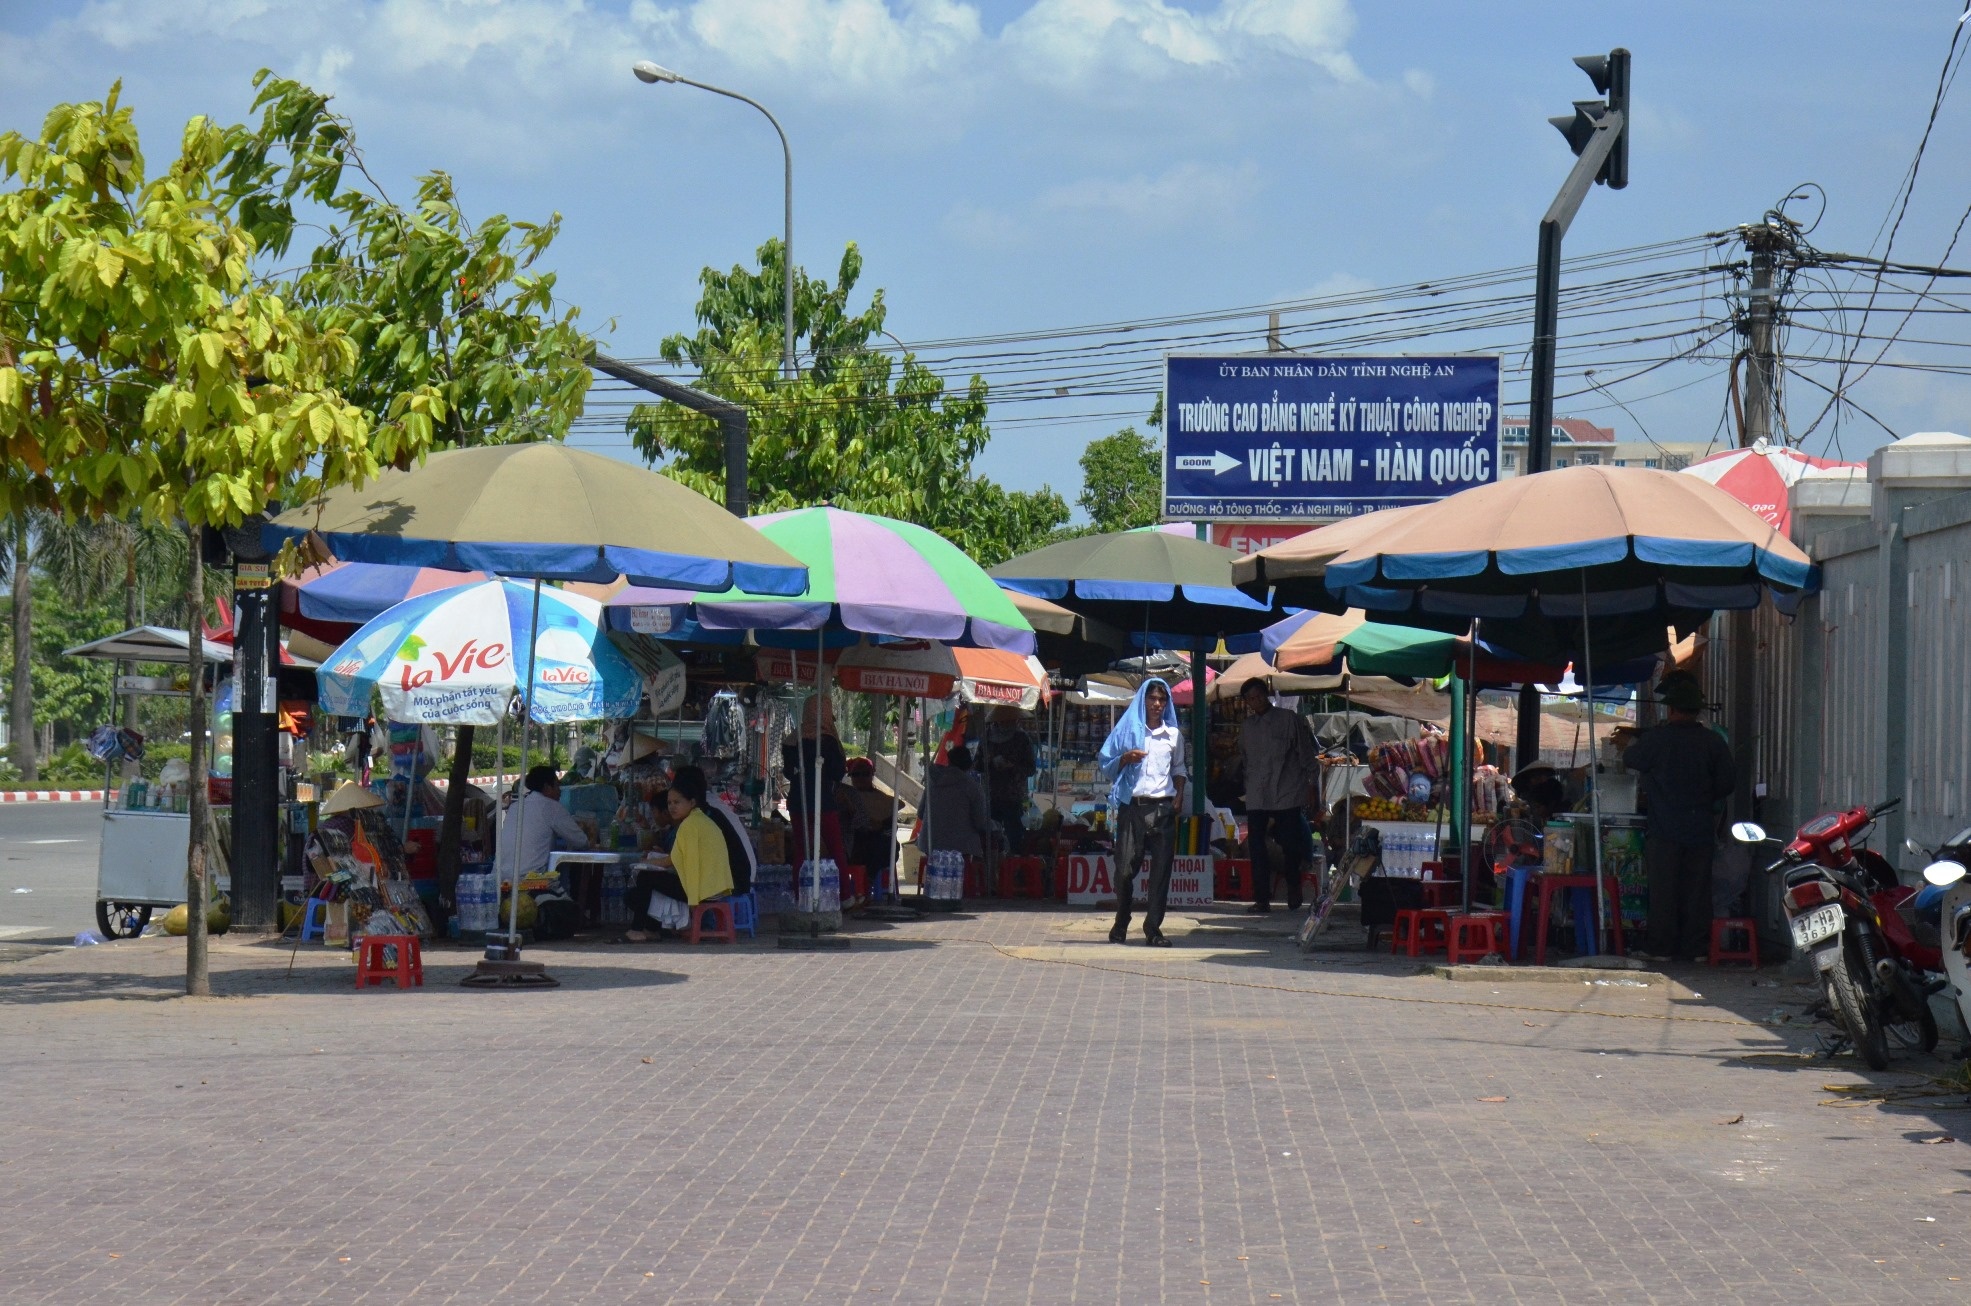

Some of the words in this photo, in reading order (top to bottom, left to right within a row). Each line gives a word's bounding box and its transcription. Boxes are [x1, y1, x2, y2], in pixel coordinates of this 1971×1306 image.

[1219, 362, 1238, 377] ỦY
[1241, 366, 1270, 377] BAN
[1274, 363, 1314, 377] NHÂN
[1317, 363, 1347, 377] DÂN
[1351, 361, 1387, 377] TỈNH
[1390, 363, 1431, 379] NGHỆ
[1434, 365, 1455, 376] AN
[1178, 395, 1230, 432] TRƯỜNG
[1232, 402, 1258, 432] CAO
[1261, 389, 1297, 432] ĐẲNG
[1300, 391, 1336, 432] NGHỀ
[1339, 396, 1357, 432] KỸ
[1360, 396, 1401, 437] THUẬT
[1403, 395, 1440, 432] CÔNG
[1443, 396, 1492, 437] NGHIỆP
[1182, 459, 1212, 467] 600M
[1248, 441, 1296, 488] VIỆT
[1301, 448, 1353, 482] NAM
[1375, 441, 1423, 482] HÀN
[1429, 435, 1490, 485] QUỐC
[1168, 502, 1207, 514] ĐƯỜNG:
[1226, 502, 1252, 514] TÔNG
[1254, 499, 1281, 514] THỐC
[1290, 502, 1305, 514] XÃ
[1307, 505, 1332, 514] NGHI
[1333, 502, 1353, 514] PHÚ
[864, 674, 883, 686] BIA
[413, 696, 435, 707] Một
[462, 685, 478, 698] tất
[479, 684, 498, 698] yếu
[977, 684, 992, 696] BIA
[421, 706, 440, 719] của
[441, 703, 465, 718] cuộc
[465, 698, 491, 710] sống
[1802, 922, 1835, 943] 3637
